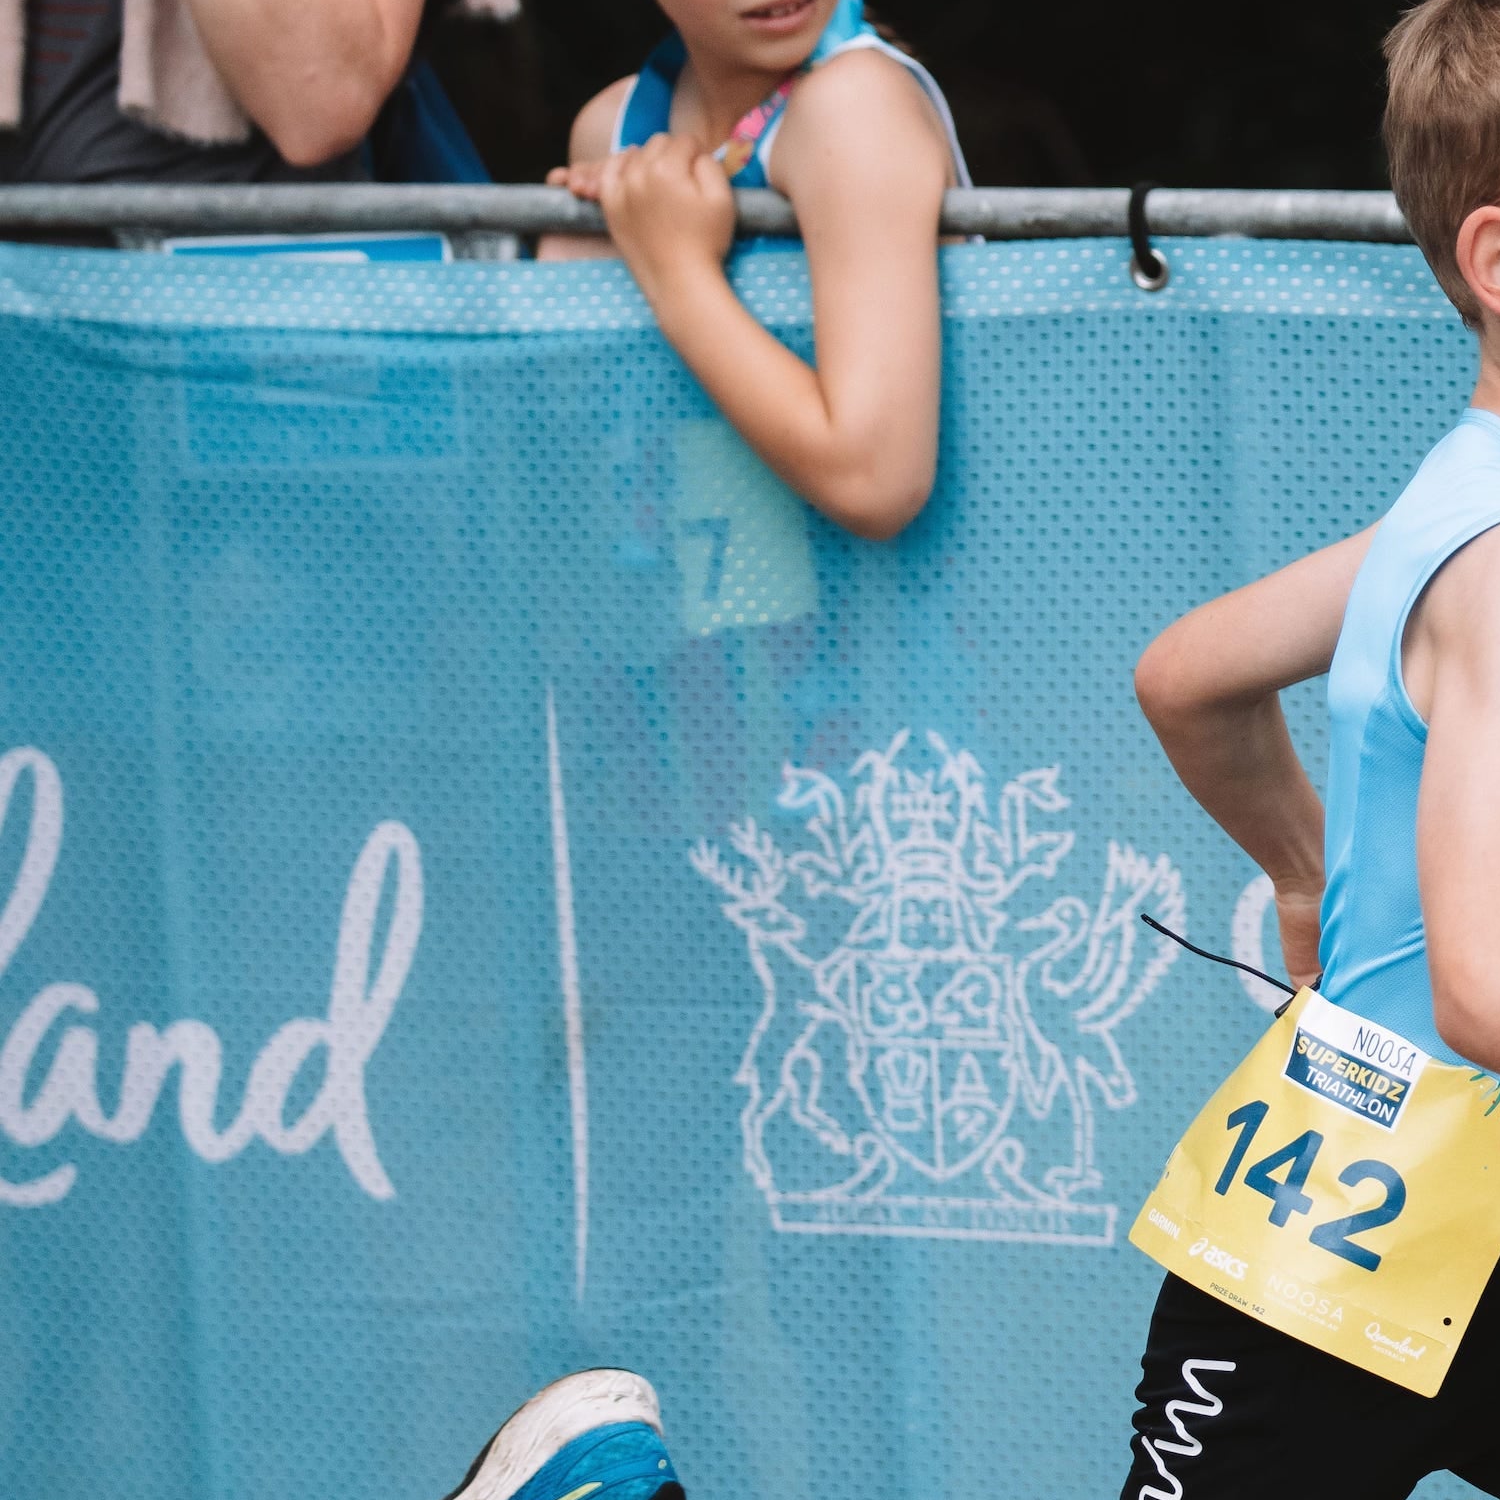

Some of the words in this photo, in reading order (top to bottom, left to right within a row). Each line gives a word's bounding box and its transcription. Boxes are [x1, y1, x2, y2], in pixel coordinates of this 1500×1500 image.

[1296, 1036, 1406, 1102] SUPERKIDZ
[1352, 1026, 1417, 1076] NOOSA
[1304, 1066, 1396, 1122] TRIATHLON
[1214, 1100, 1407, 1272] 142
[1148, 1208, 1181, 1239] GARMIN
[1203, 1245, 1249, 1280] asics
[1209, 1282, 1228, 1297] PRIZE
[1228, 1292, 1249, 1307] DRAW
[1252, 1304, 1266, 1315] 142
[1266, 1274, 1344, 1323] NOOSA
